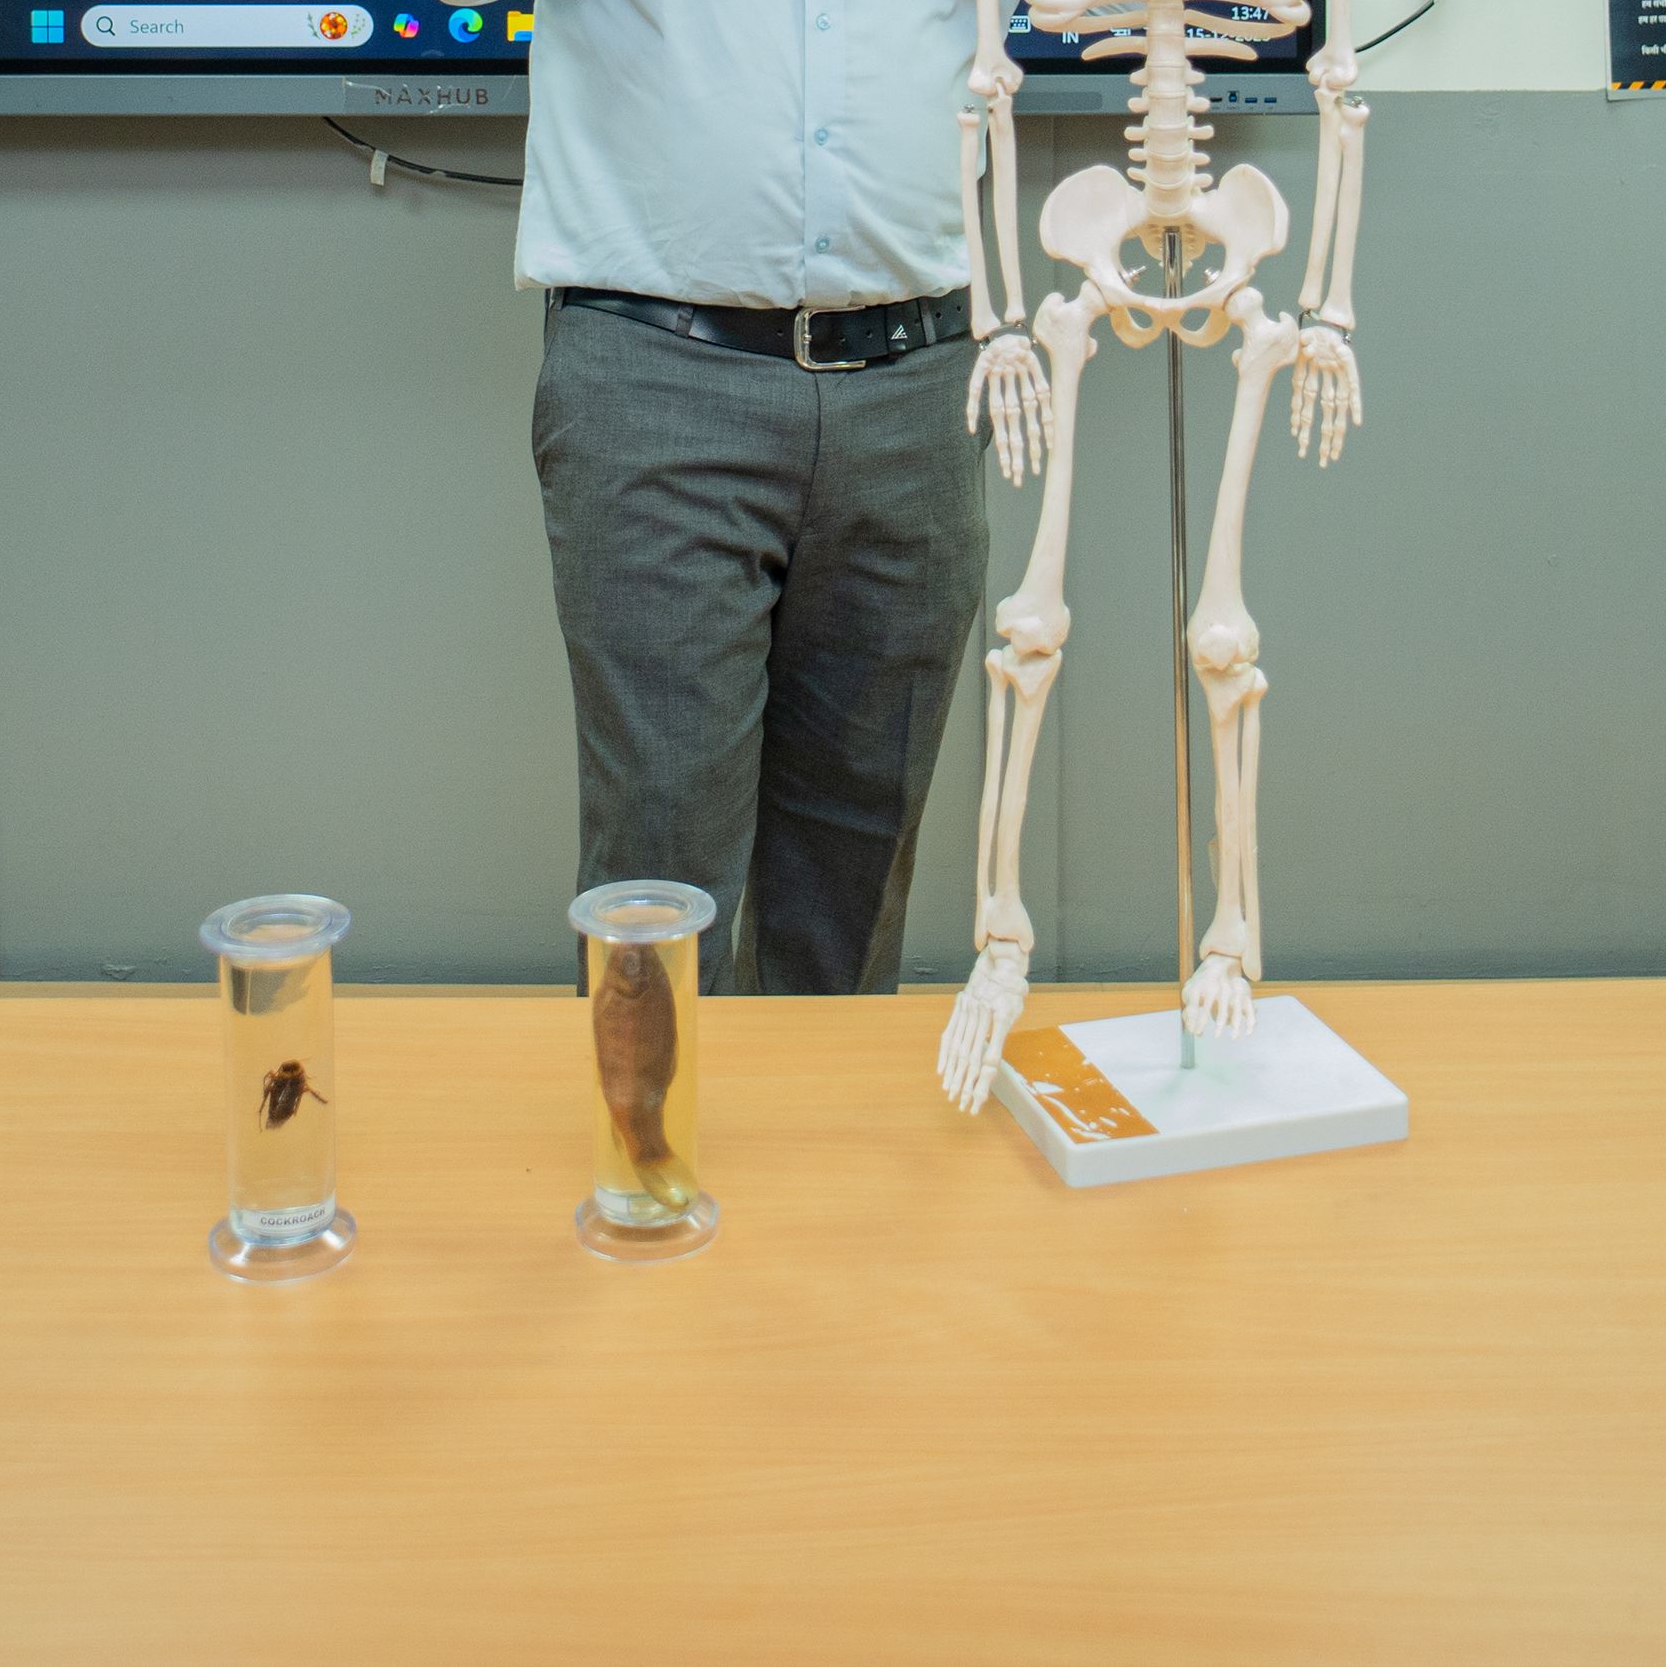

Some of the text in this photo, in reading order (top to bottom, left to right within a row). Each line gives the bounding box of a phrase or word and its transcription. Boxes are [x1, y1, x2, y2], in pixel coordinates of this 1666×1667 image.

[1231, 6, 1269, 21] 13:47
[130, 19, 184, 34] Search
[1062, 31, 1079, 44] IN
[375, 88, 490, 106] MAXHUB
[260, 1208, 326, 1226] COCKROACH
